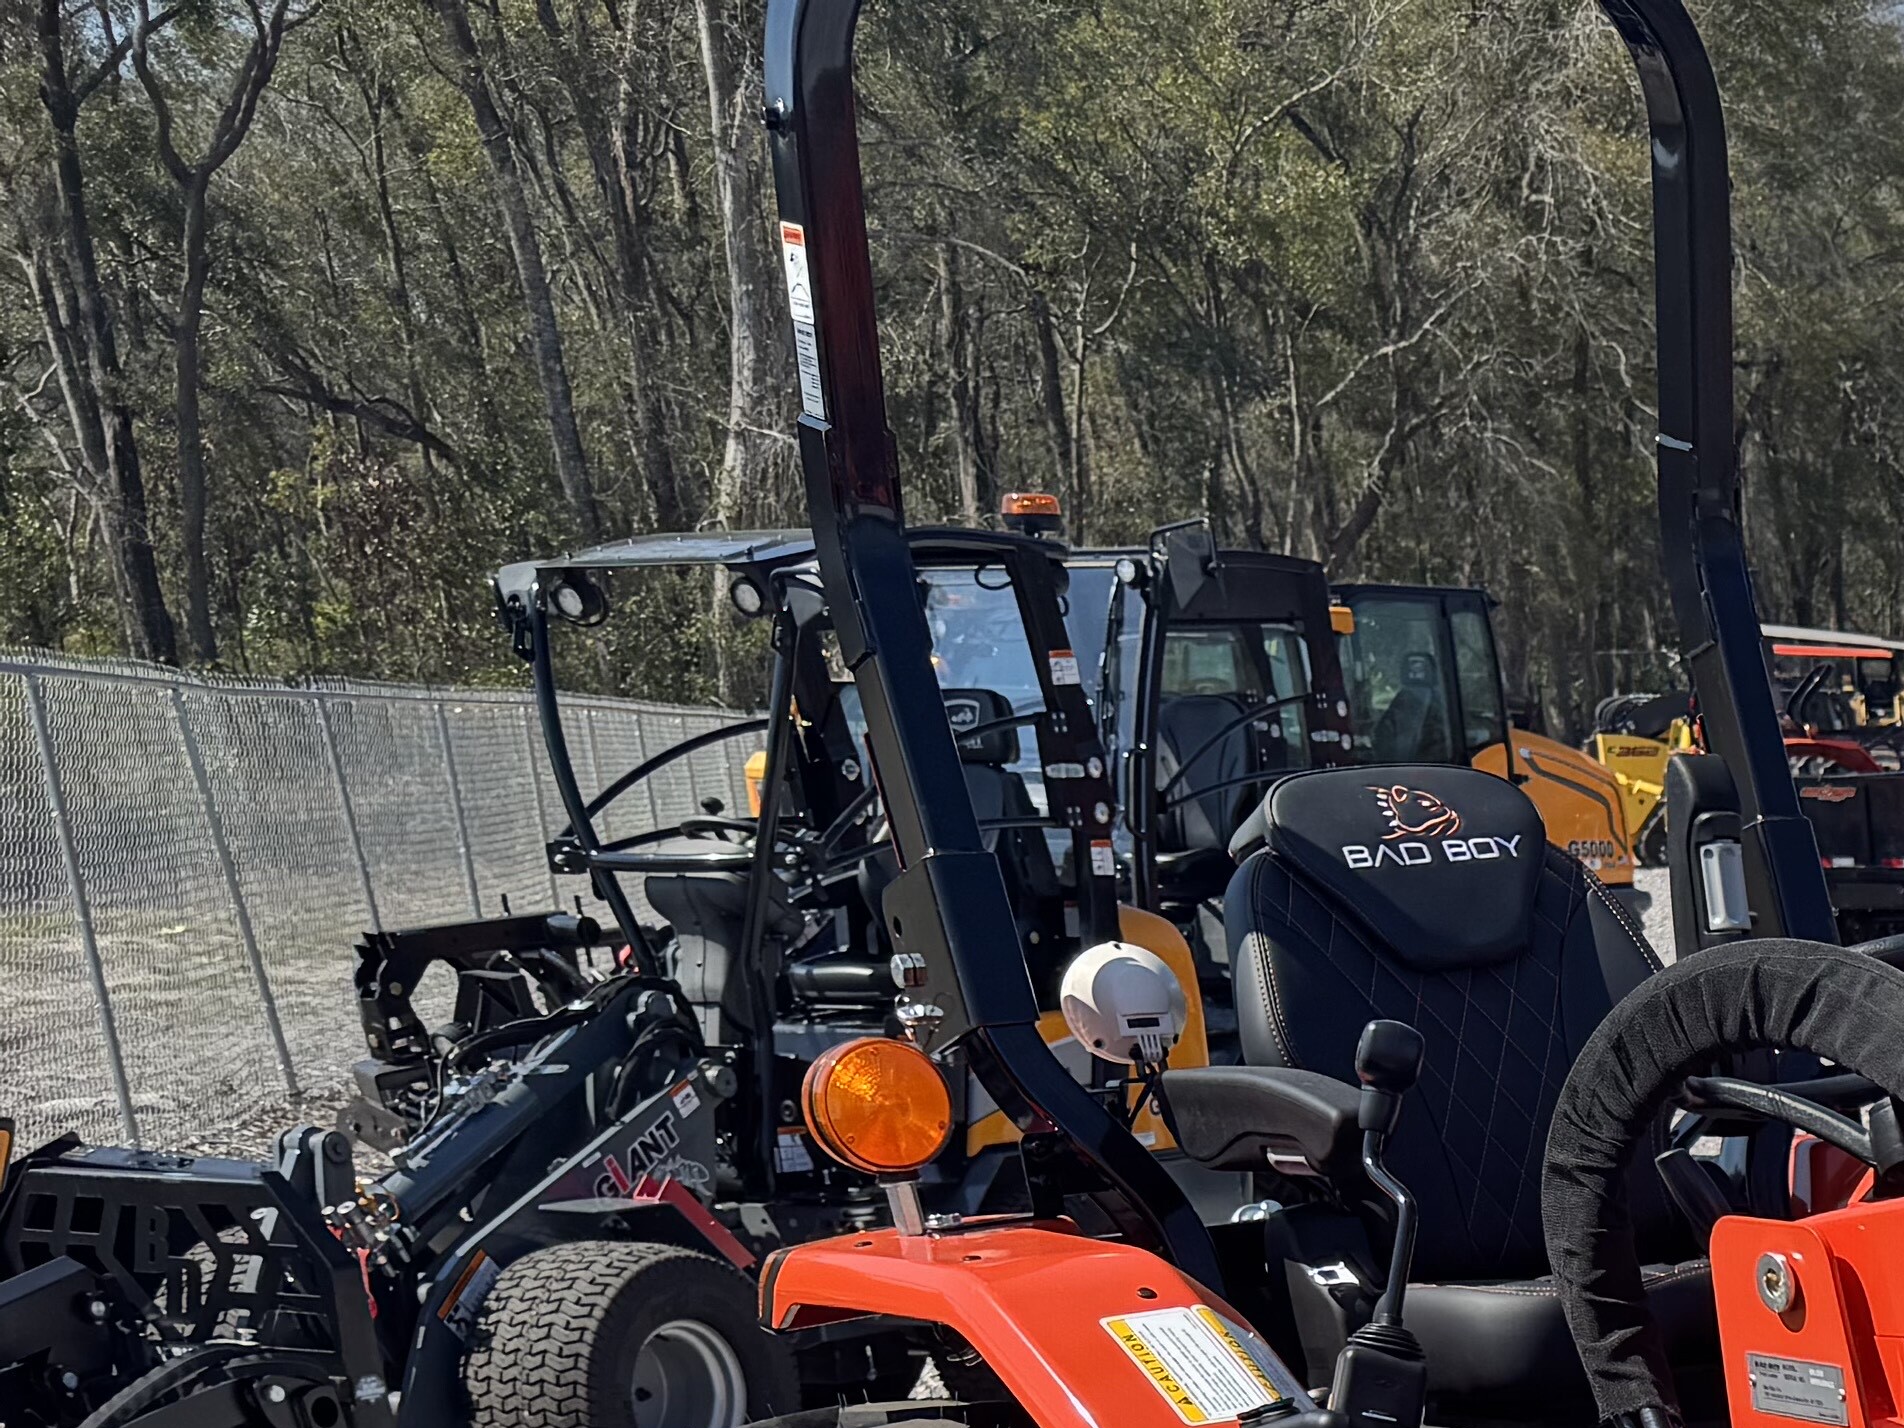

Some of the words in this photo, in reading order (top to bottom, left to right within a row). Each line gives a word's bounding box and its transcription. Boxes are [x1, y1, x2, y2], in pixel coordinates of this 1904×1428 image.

[1342, 842, 1432, 870] BAD
[1442, 833, 1523, 863] BOY
[1568, 841, 1614, 858] G5000
[593, 1111, 680, 1199] GIANT
[1123, 1334, 1180, 1393] CAUTION
